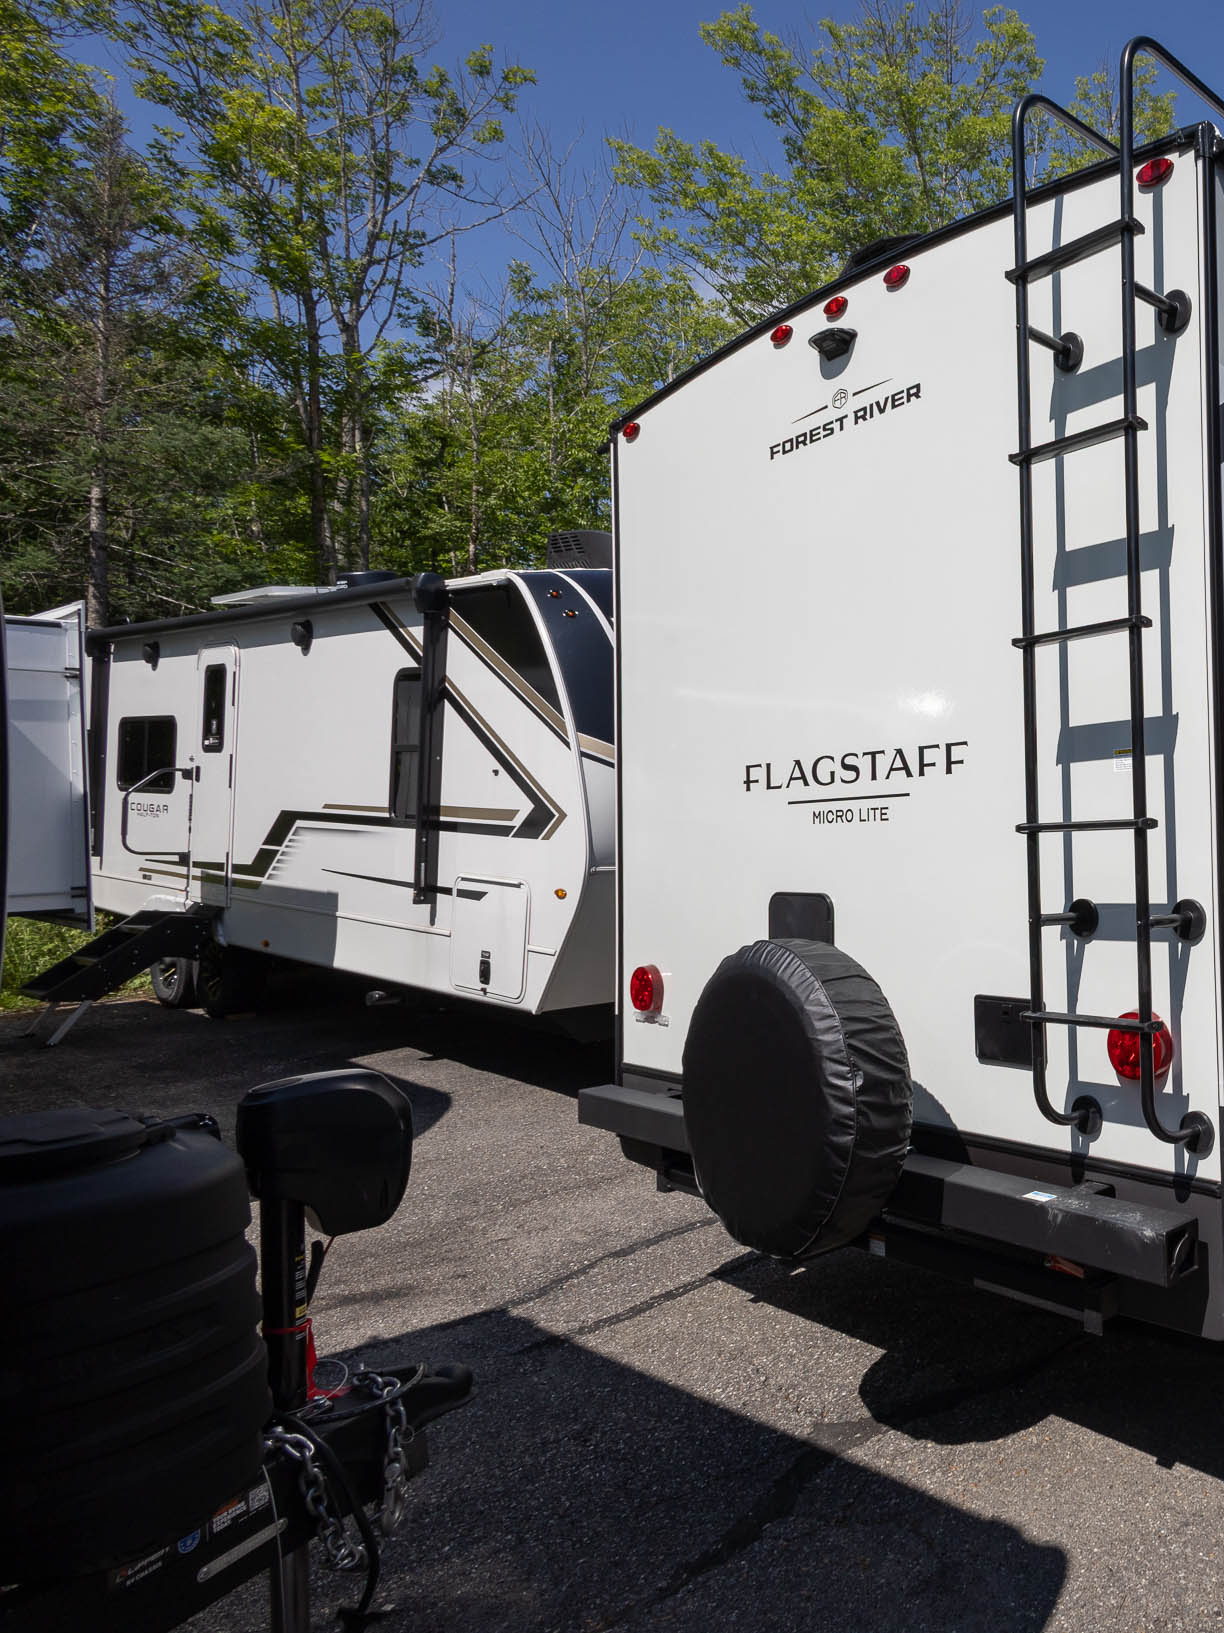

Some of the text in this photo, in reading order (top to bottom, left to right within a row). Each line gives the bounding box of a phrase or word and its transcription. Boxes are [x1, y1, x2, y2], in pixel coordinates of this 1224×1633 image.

[769, 382, 921, 460] FOREST RIVER
[743, 740, 968, 792] FLAGSTAFF
[130, 802, 169, 814] COUGAR
[812, 806, 889, 825] MICRO LITE
